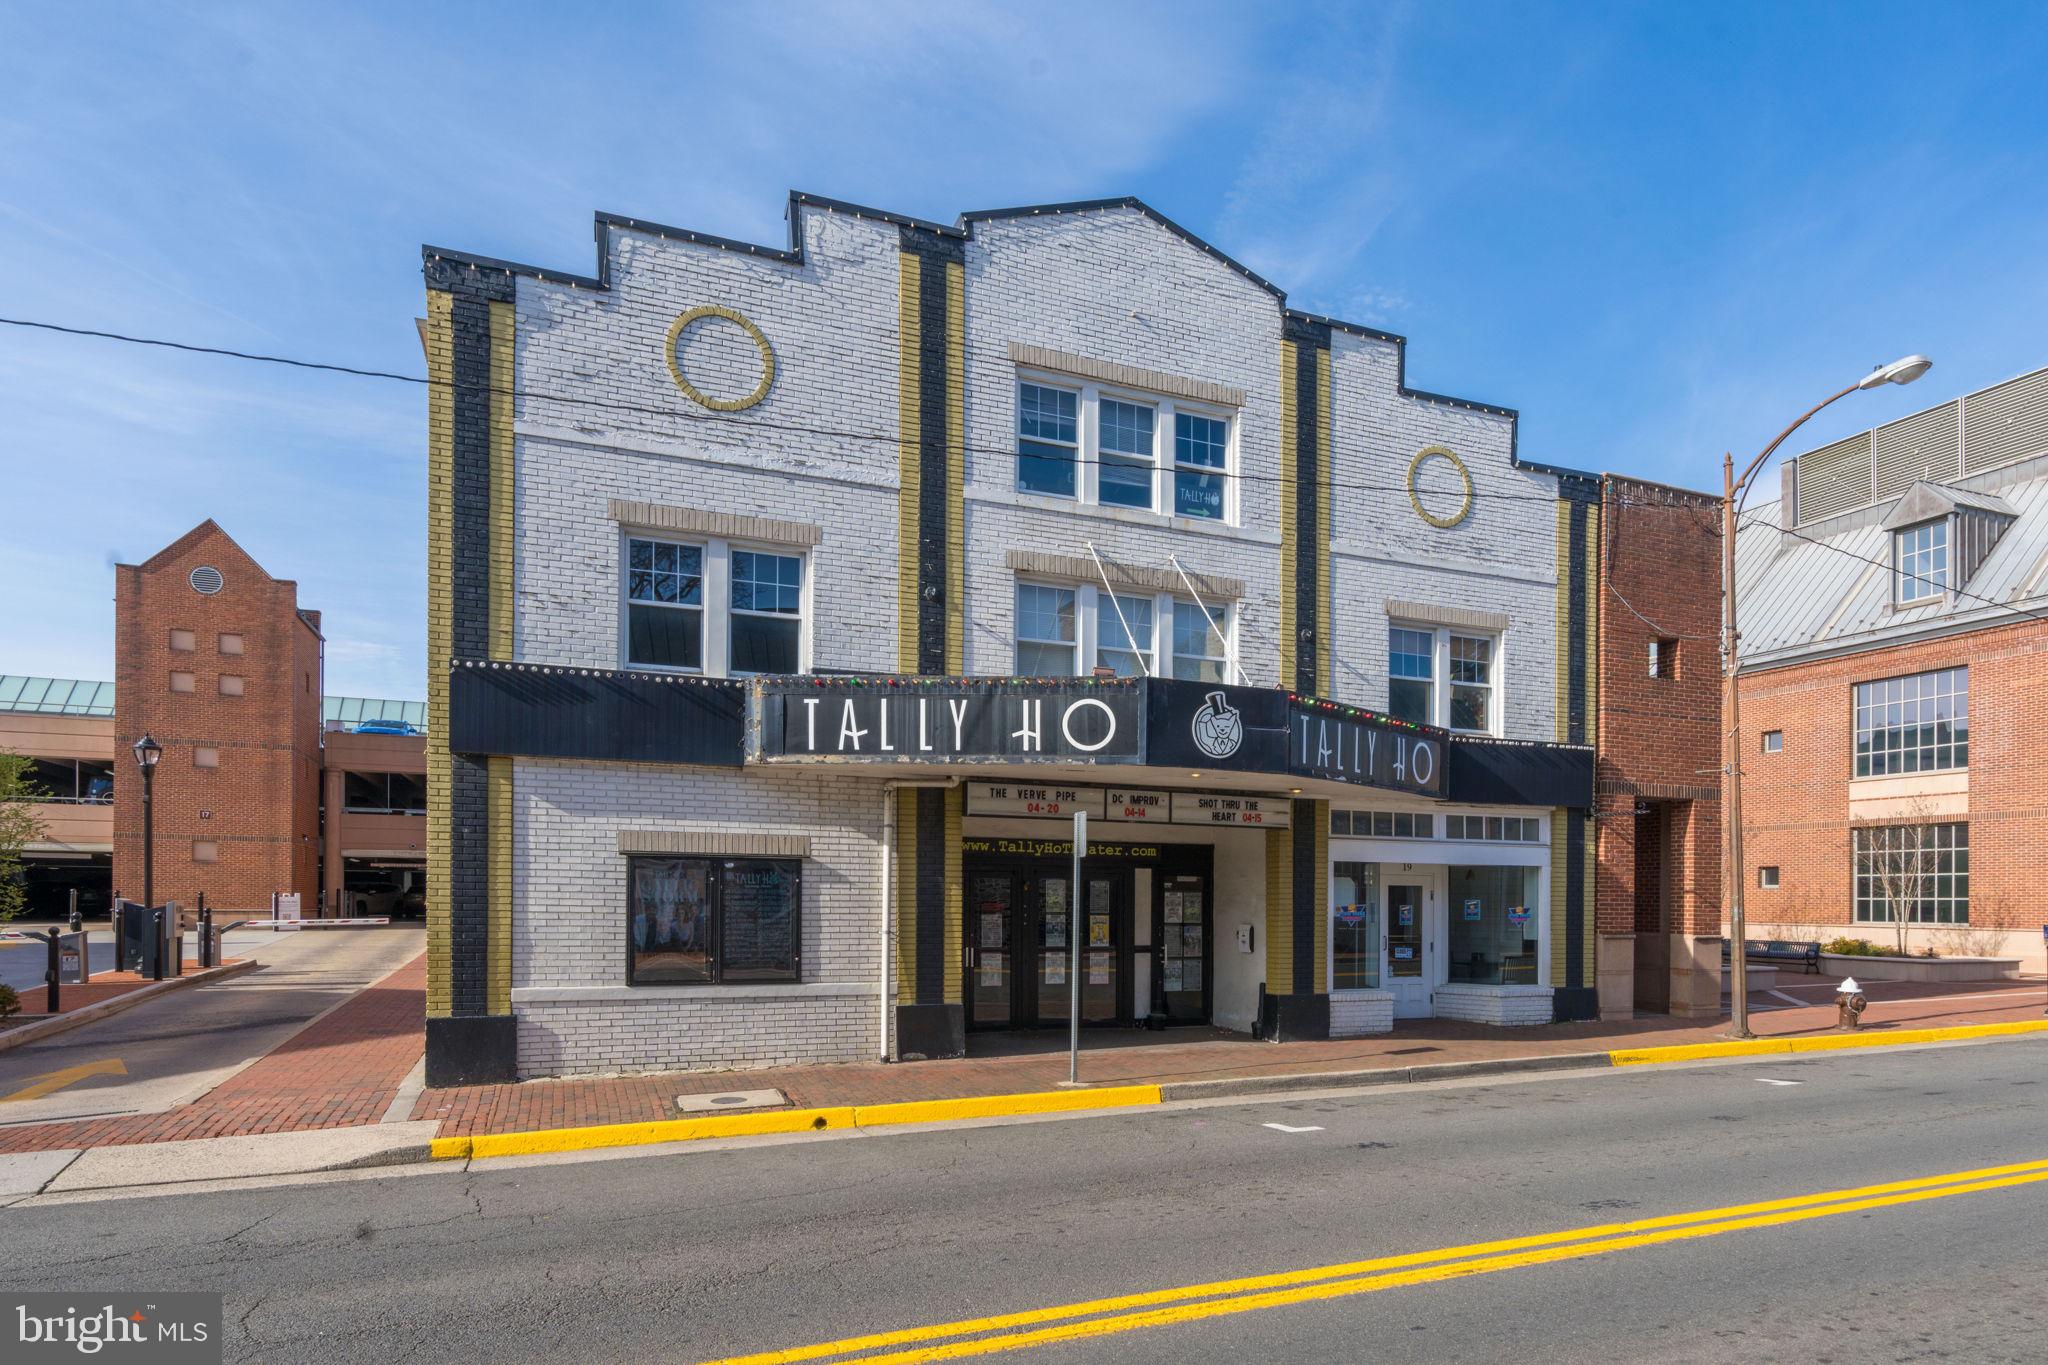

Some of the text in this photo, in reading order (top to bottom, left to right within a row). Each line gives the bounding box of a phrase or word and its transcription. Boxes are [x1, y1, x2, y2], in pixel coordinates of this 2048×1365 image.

[803, 698, 1116, 752] TALLY HO
[1300, 715, 1433, 784] TALLY HO
[990, 787, 1076, 802] THE VERVE PIPE
[1112, 793, 1159, 806] DC IMPROV
[1027, 803, 1060, 814] 04-20
[1199, 799, 1258, 811] SHOT THRU THE
[1124, 808, 1146, 818] 04-14
[1212, 812, 1262, 823] HEART 04-15
[963, 840, 1157, 858] www.TallyHoTater.com
[1402, 863, 1413, 872] 19
